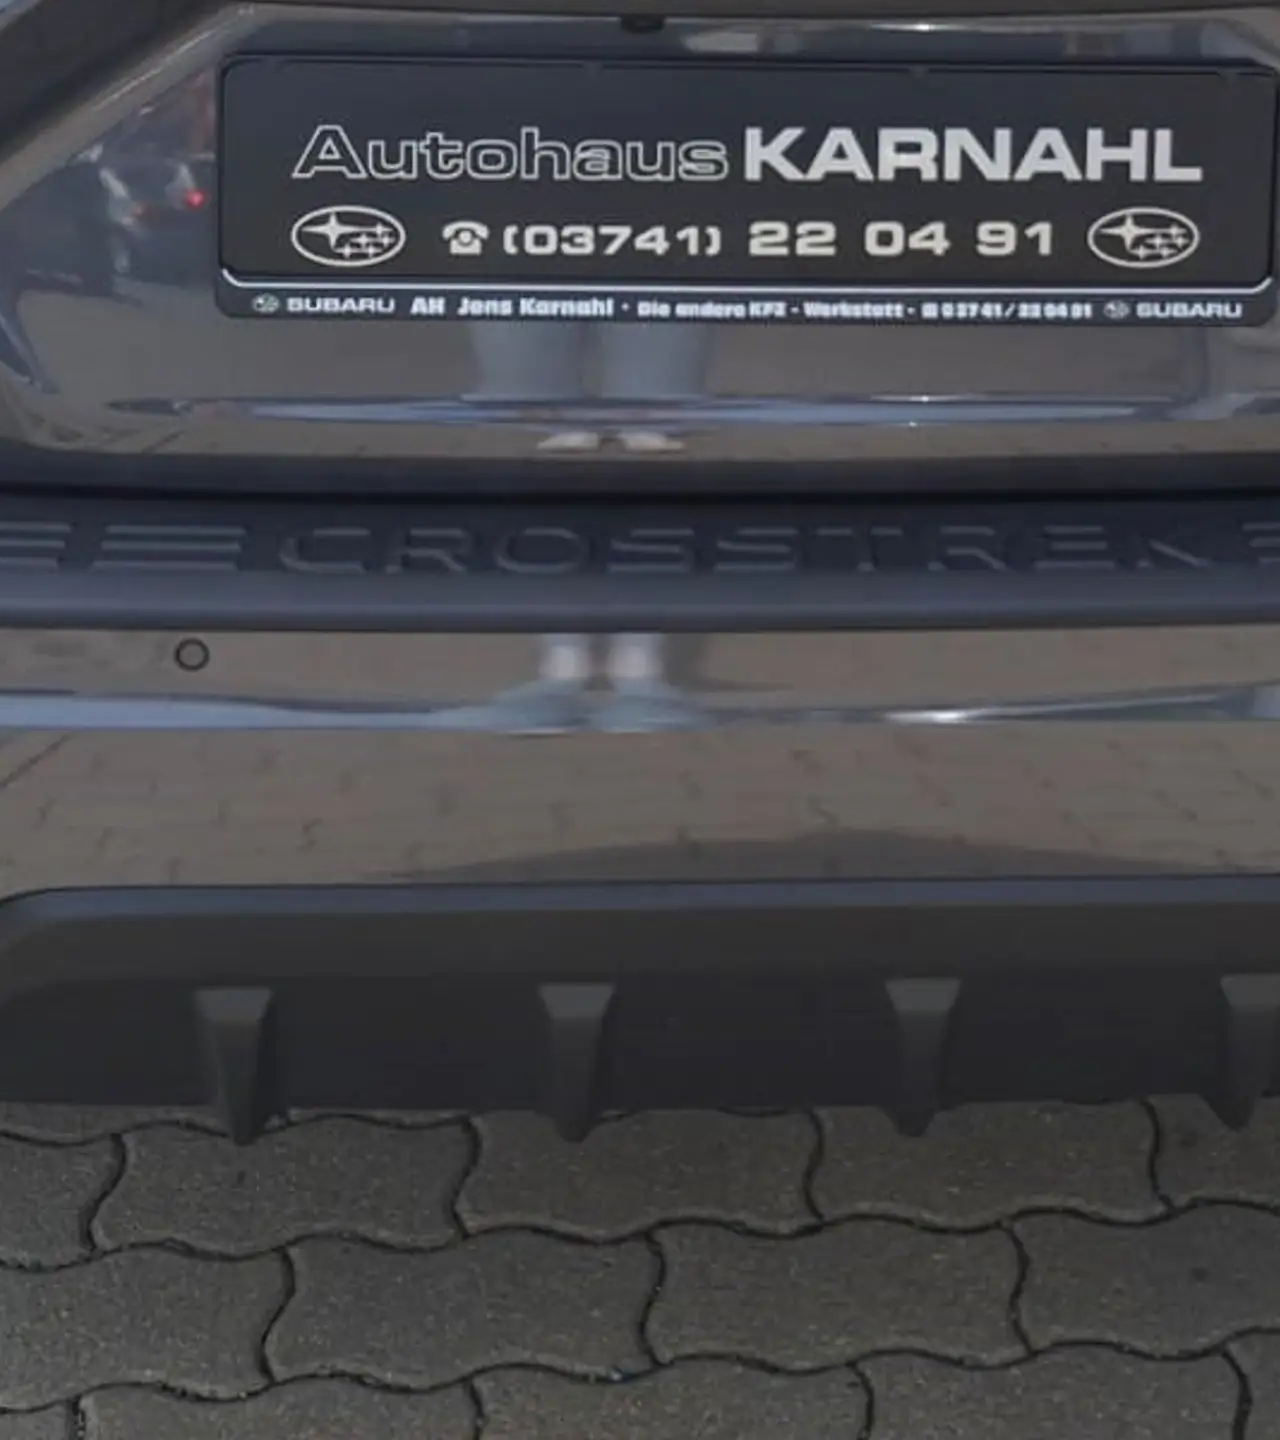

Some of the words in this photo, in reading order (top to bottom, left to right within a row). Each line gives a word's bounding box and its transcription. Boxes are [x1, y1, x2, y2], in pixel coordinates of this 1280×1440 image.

[291, 124, 727, 180] Autohaus
[743, 127, 1203, 182] KARNAHL
[503, 224, 722, 256] (03741)
[748, 221, 836, 257] 22
[864, 221, 950, 257] 04
[976, 221, 1053, 257] 91
[286, 296, 395, 313] SUBARU
[410, 296, 445, 315] AH
[458, 296, 513, 315] Jens
[519, 297, 614, 317] Karnahl
[637, 301, 669, 317] Die
[1136, 303, 1242, 319] SUBARU
[278, 524, 1214, 574] CROSSTREK
